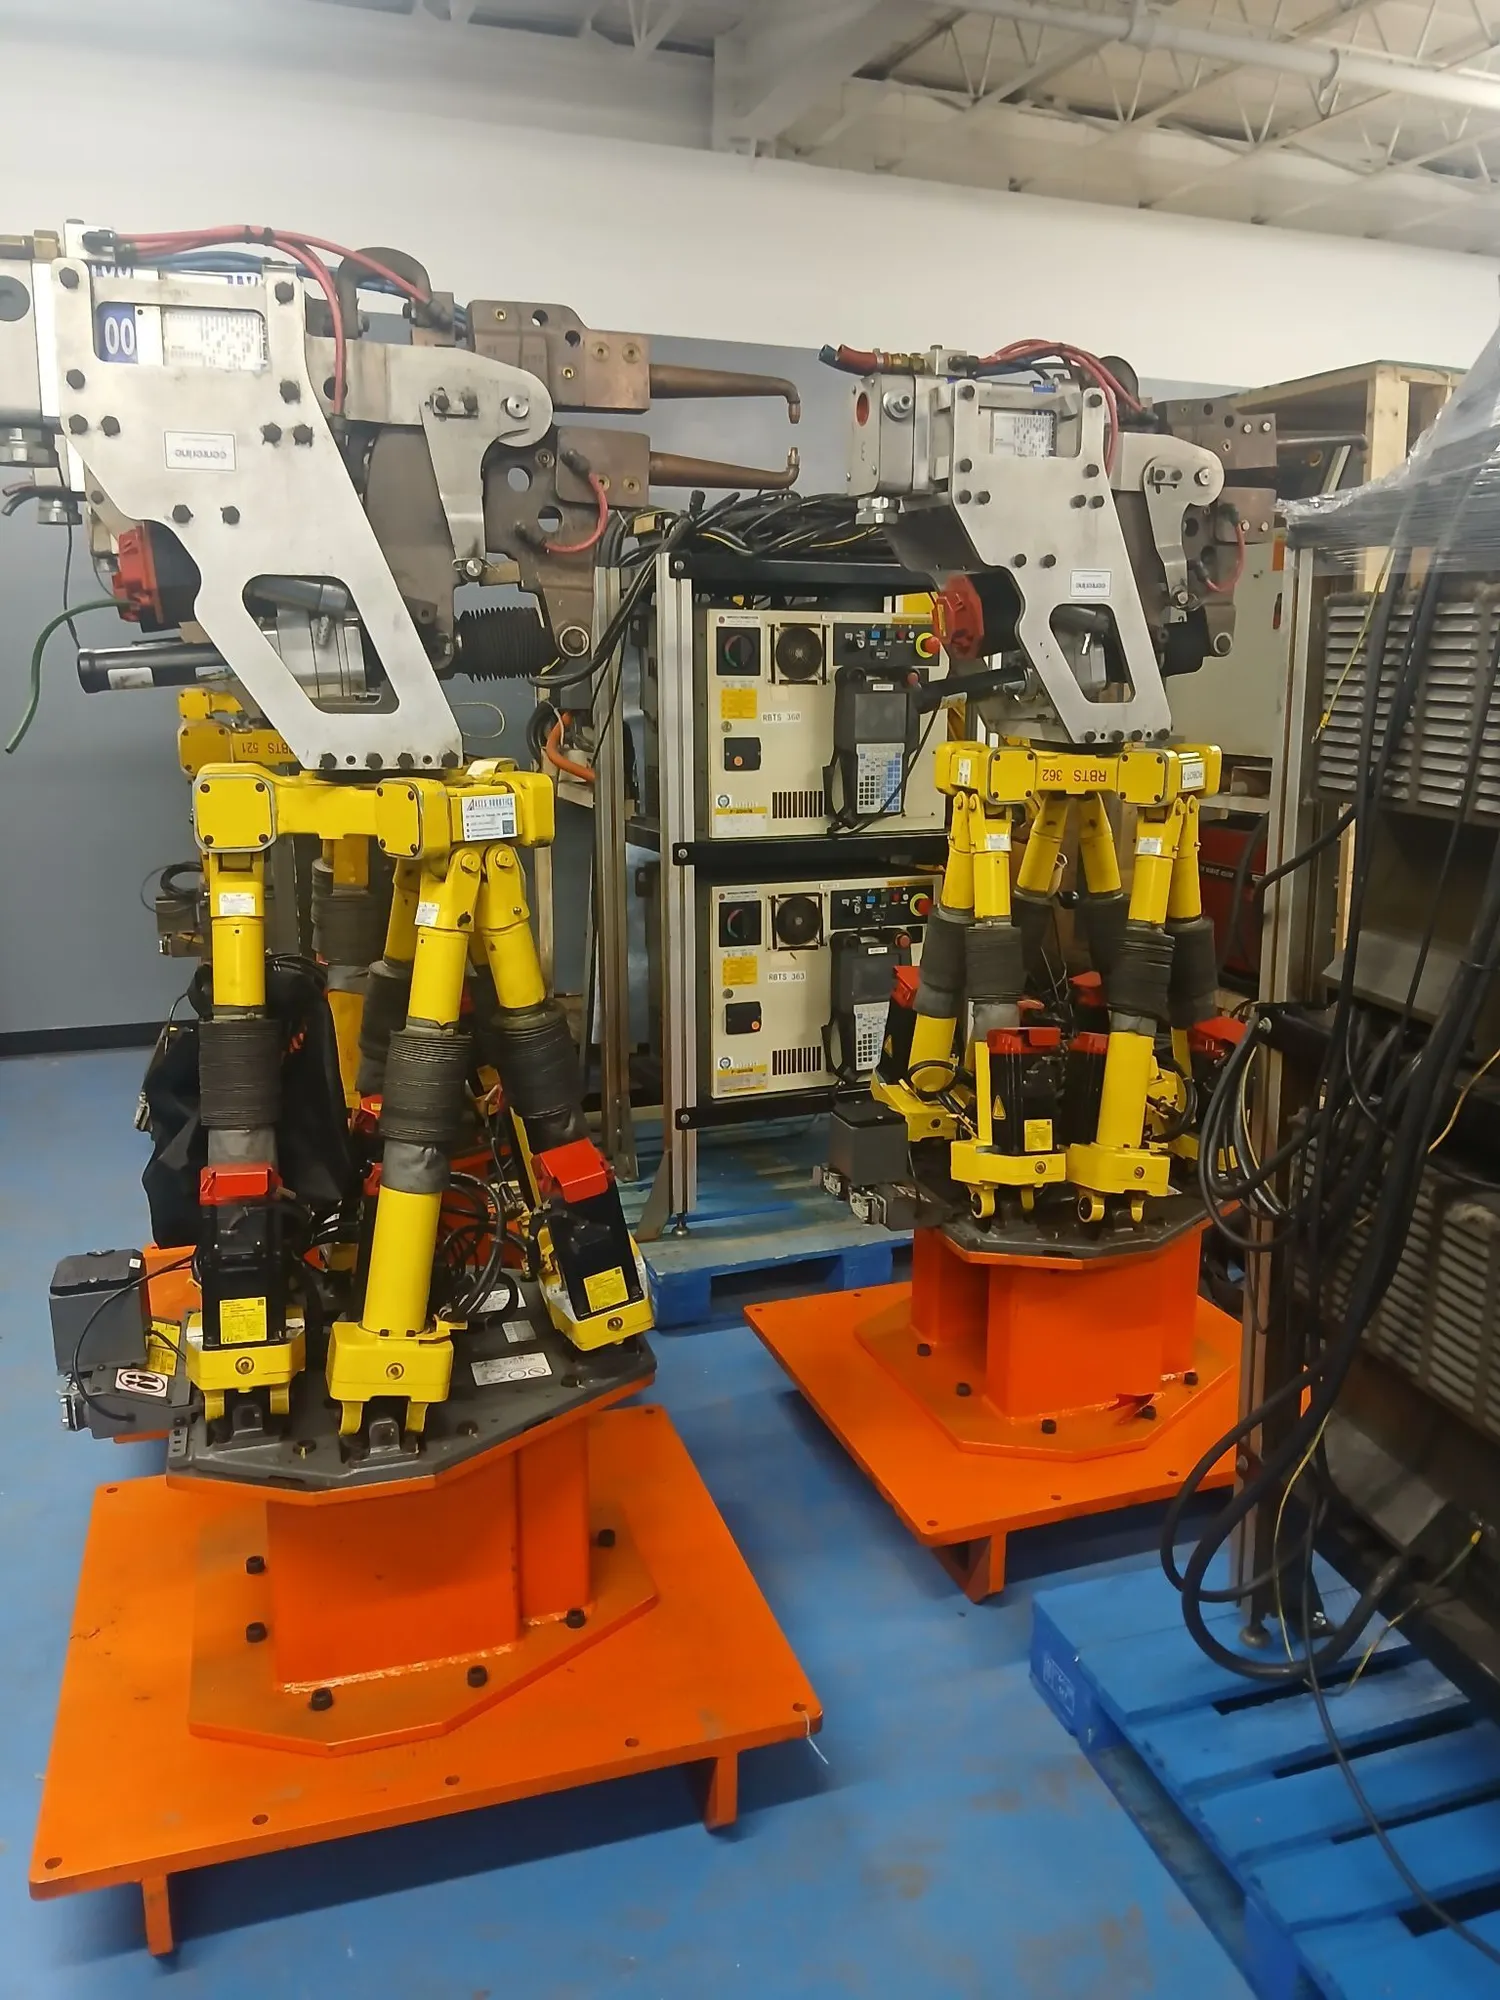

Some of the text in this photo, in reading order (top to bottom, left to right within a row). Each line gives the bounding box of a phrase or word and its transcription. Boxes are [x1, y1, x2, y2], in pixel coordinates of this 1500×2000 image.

[241, 742, 259, 754] 521
[1042, 769, 1107, 783] RBTS 362
[791, 972, 805, 981] 363
